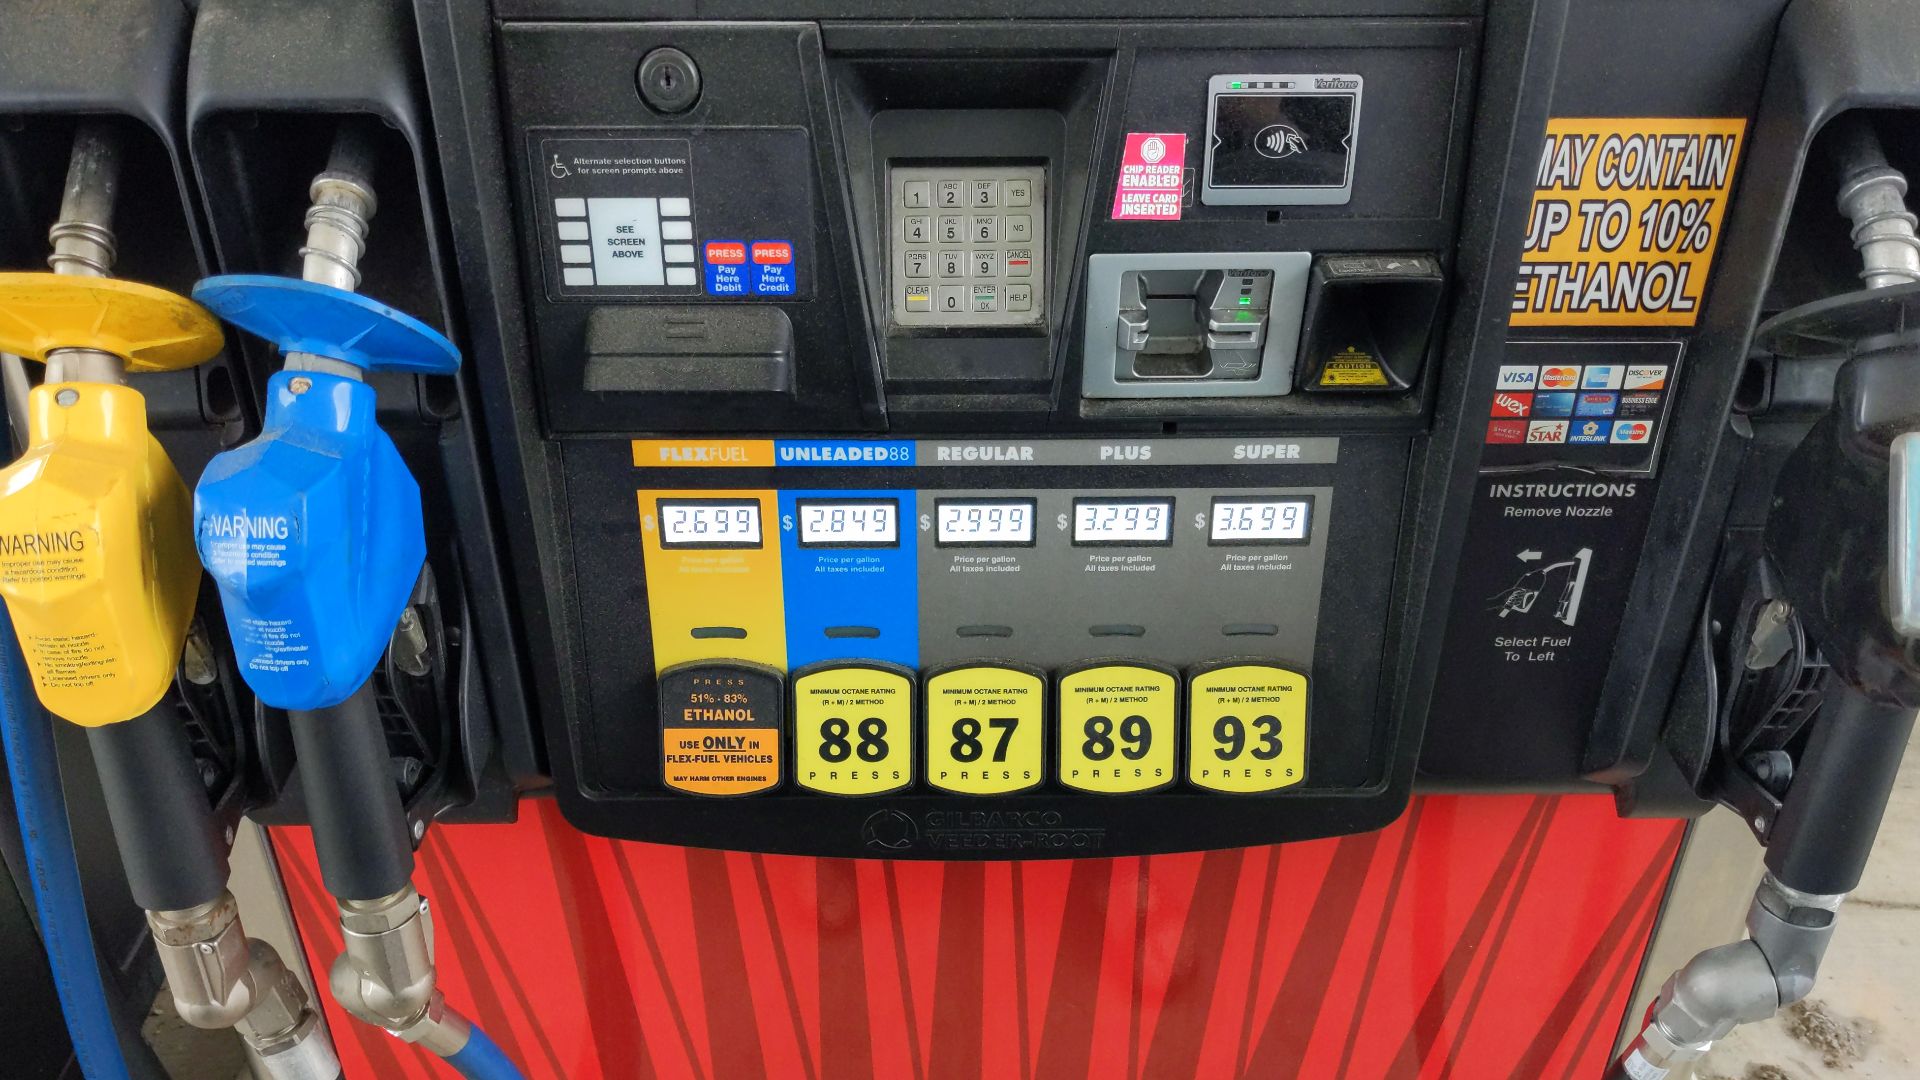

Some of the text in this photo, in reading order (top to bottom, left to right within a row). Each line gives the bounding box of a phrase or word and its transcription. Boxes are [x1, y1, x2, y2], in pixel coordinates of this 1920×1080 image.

[1314, 78, 1359, 90] Verifone
[574, 157, 686, 166] Alternate selection buttons
[1596, 133, 1737, 190] CONTAIN
[577, 166, 684, 176] for screen prompts above
[1123, 165, 1180, 175] CHIP READER
[1122, 175, 1180, 188] ENABLED
[913, 192, 919, 204] 1
[946, 191, 955, 203] 2
[980, 191, 989, 203] 3
[1122, 194, 1178, 203] LEAVE CARD
[1120, 203, 1178, 216] INSERTED
[616, 226, 634, 234] SEE
[1578, 199, 1632, 252] TO
[1638, 199, 1715, 252] 10%
[913, 227, 921, 239] 4
[946, 227, 955, 239] 5
[980, 227, 989, 239] 6
[607, 238, 645, 246] SCREEN
[612, 250, 644, 258] ABOVE
[708, 249, 743, 259] PRESS
[754, 249, 789, 259] PRESS
[1006, 251, 1031, 259] CANCEL
[717, 265, 736, 276] Pay
[763, 265, 782, 276] Pay
[913, 262, 922, 273] 7
[947, 262, 955, 274] 8
[980, 262, 989, 274] 9
[716, 274, 740, 283] Here
[761, 274, 785, 283] Here
[715, 283, 742, 292] Debit
[758, 283, 790, 292] Credit
[906, 286, 929, 294] CLEAR
[973, 286, 996, 294] ENTER
[947, 296, 956, 308] 0
[1503, 372, 1534, 383] VISA
[1529, 431, 1562, 442] STAR
[660, 446, 749, 461] FLEXFUEL
[937, 446, 1033, 461] REGULAR
[1100, 445, 1152, 460] PLUS
[1233, 444, 1301, 459] SUPER
[1489, 483, 1637, 498] INSTRUCTIONS
[1504, 505, 1613, 517] Remove Nozzle
[672, 509, 751, 534] 2.699
[782, 508, 887, 533] $ 2.849
[919, 508, 1024, 533] $ 2.999
[1056, 506, 1161, 531] $ 3.299
[1194, 506, 1298, 531] $ 3.699
[838, 557, 853, 565] per
[855, 556, 881, 565] gallon
[953, 555, 974, 563] Price
[991, 556, 1016, 564] gallon
[1129, 555, 1152, 563] gallon
[1248, 555, 1263, 563] per
[1265, 554, 1289, 562] gallon
[1084, 564, 1156, 572] All taxes included
[1220, 563, 1292, 571] All taxes included
[1494, 636, 1572, 648] Select Fuel
[1504, 651, 1555, 662] To Left
[690, 693, 748, 704] 51% 83%
[683, 708, 755, 722] ETHANOL
[679, 735, 760, 752] USE ONLY IN
[818, 717, 890, 763] 88
[950, 717, 1020, 763] 87
[1081, 715, 1152, 761] 89
[1212, 715, 1284, 761] 93
[666, 754, 773, 764] FLEX-FUEL VEHICLES
[926, 811, 1063, 826] GILBARCO
[926, 832, 1107, 848] VEEDER-ROOT
